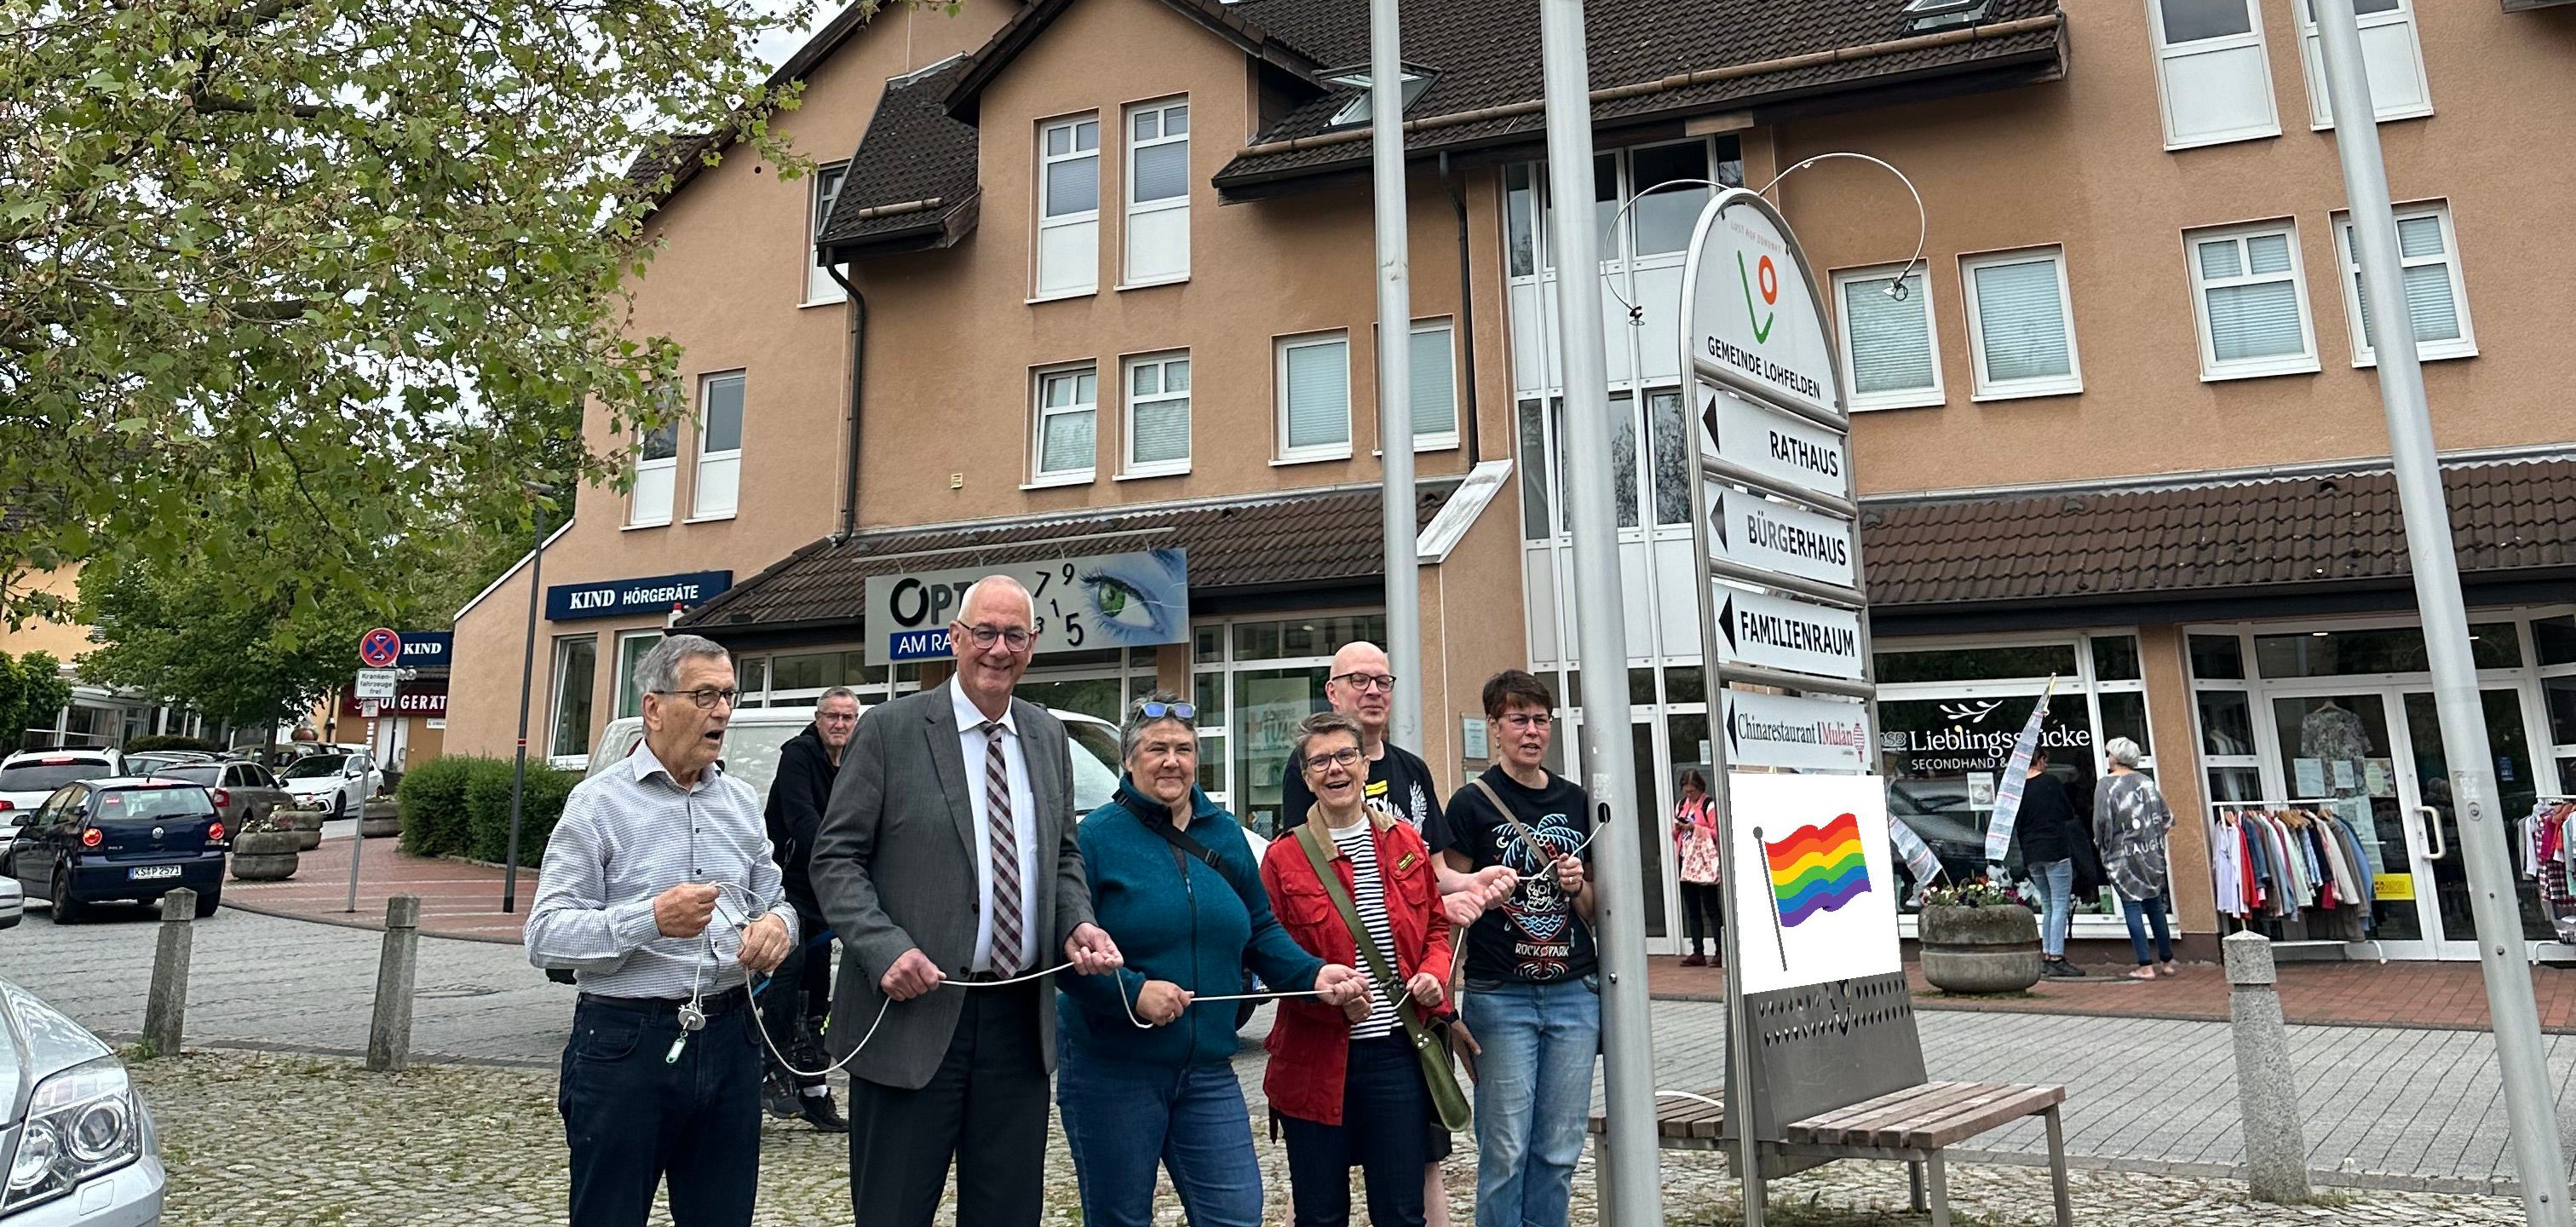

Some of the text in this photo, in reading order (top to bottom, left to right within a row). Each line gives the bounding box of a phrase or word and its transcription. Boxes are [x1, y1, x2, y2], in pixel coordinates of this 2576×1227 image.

[1708, 336, 1821, 400] GEMEINDE LOHFELDEN
[1769, 430, 1838, 477] RATHAUS
[1747, 510, 1846, 566] BÜRGERHAUS
[1035, 571, 1051, 598] 7
[1062, 563, 1075, 585] 9
[569, 584, 699, 609] KIND HÖRGERÄTE
[890, 578, 980, 627] OPT
[1050, 598, 1060, 618] 1
[1065, 612, 1084, 647] 5
[1740, 610, 1855, 658] FAMILIENRAUM
[403, 642, 442, 655] KIND
[898, 635, 927, 655] AM
[1738, 713, 1816, 744] Chinarestaurant
[1911, 757, 1996, 770] SECONDHAND
[135, 867, 147, 877] KS
[1515, 942, 1570, 957] ROCK PARK
